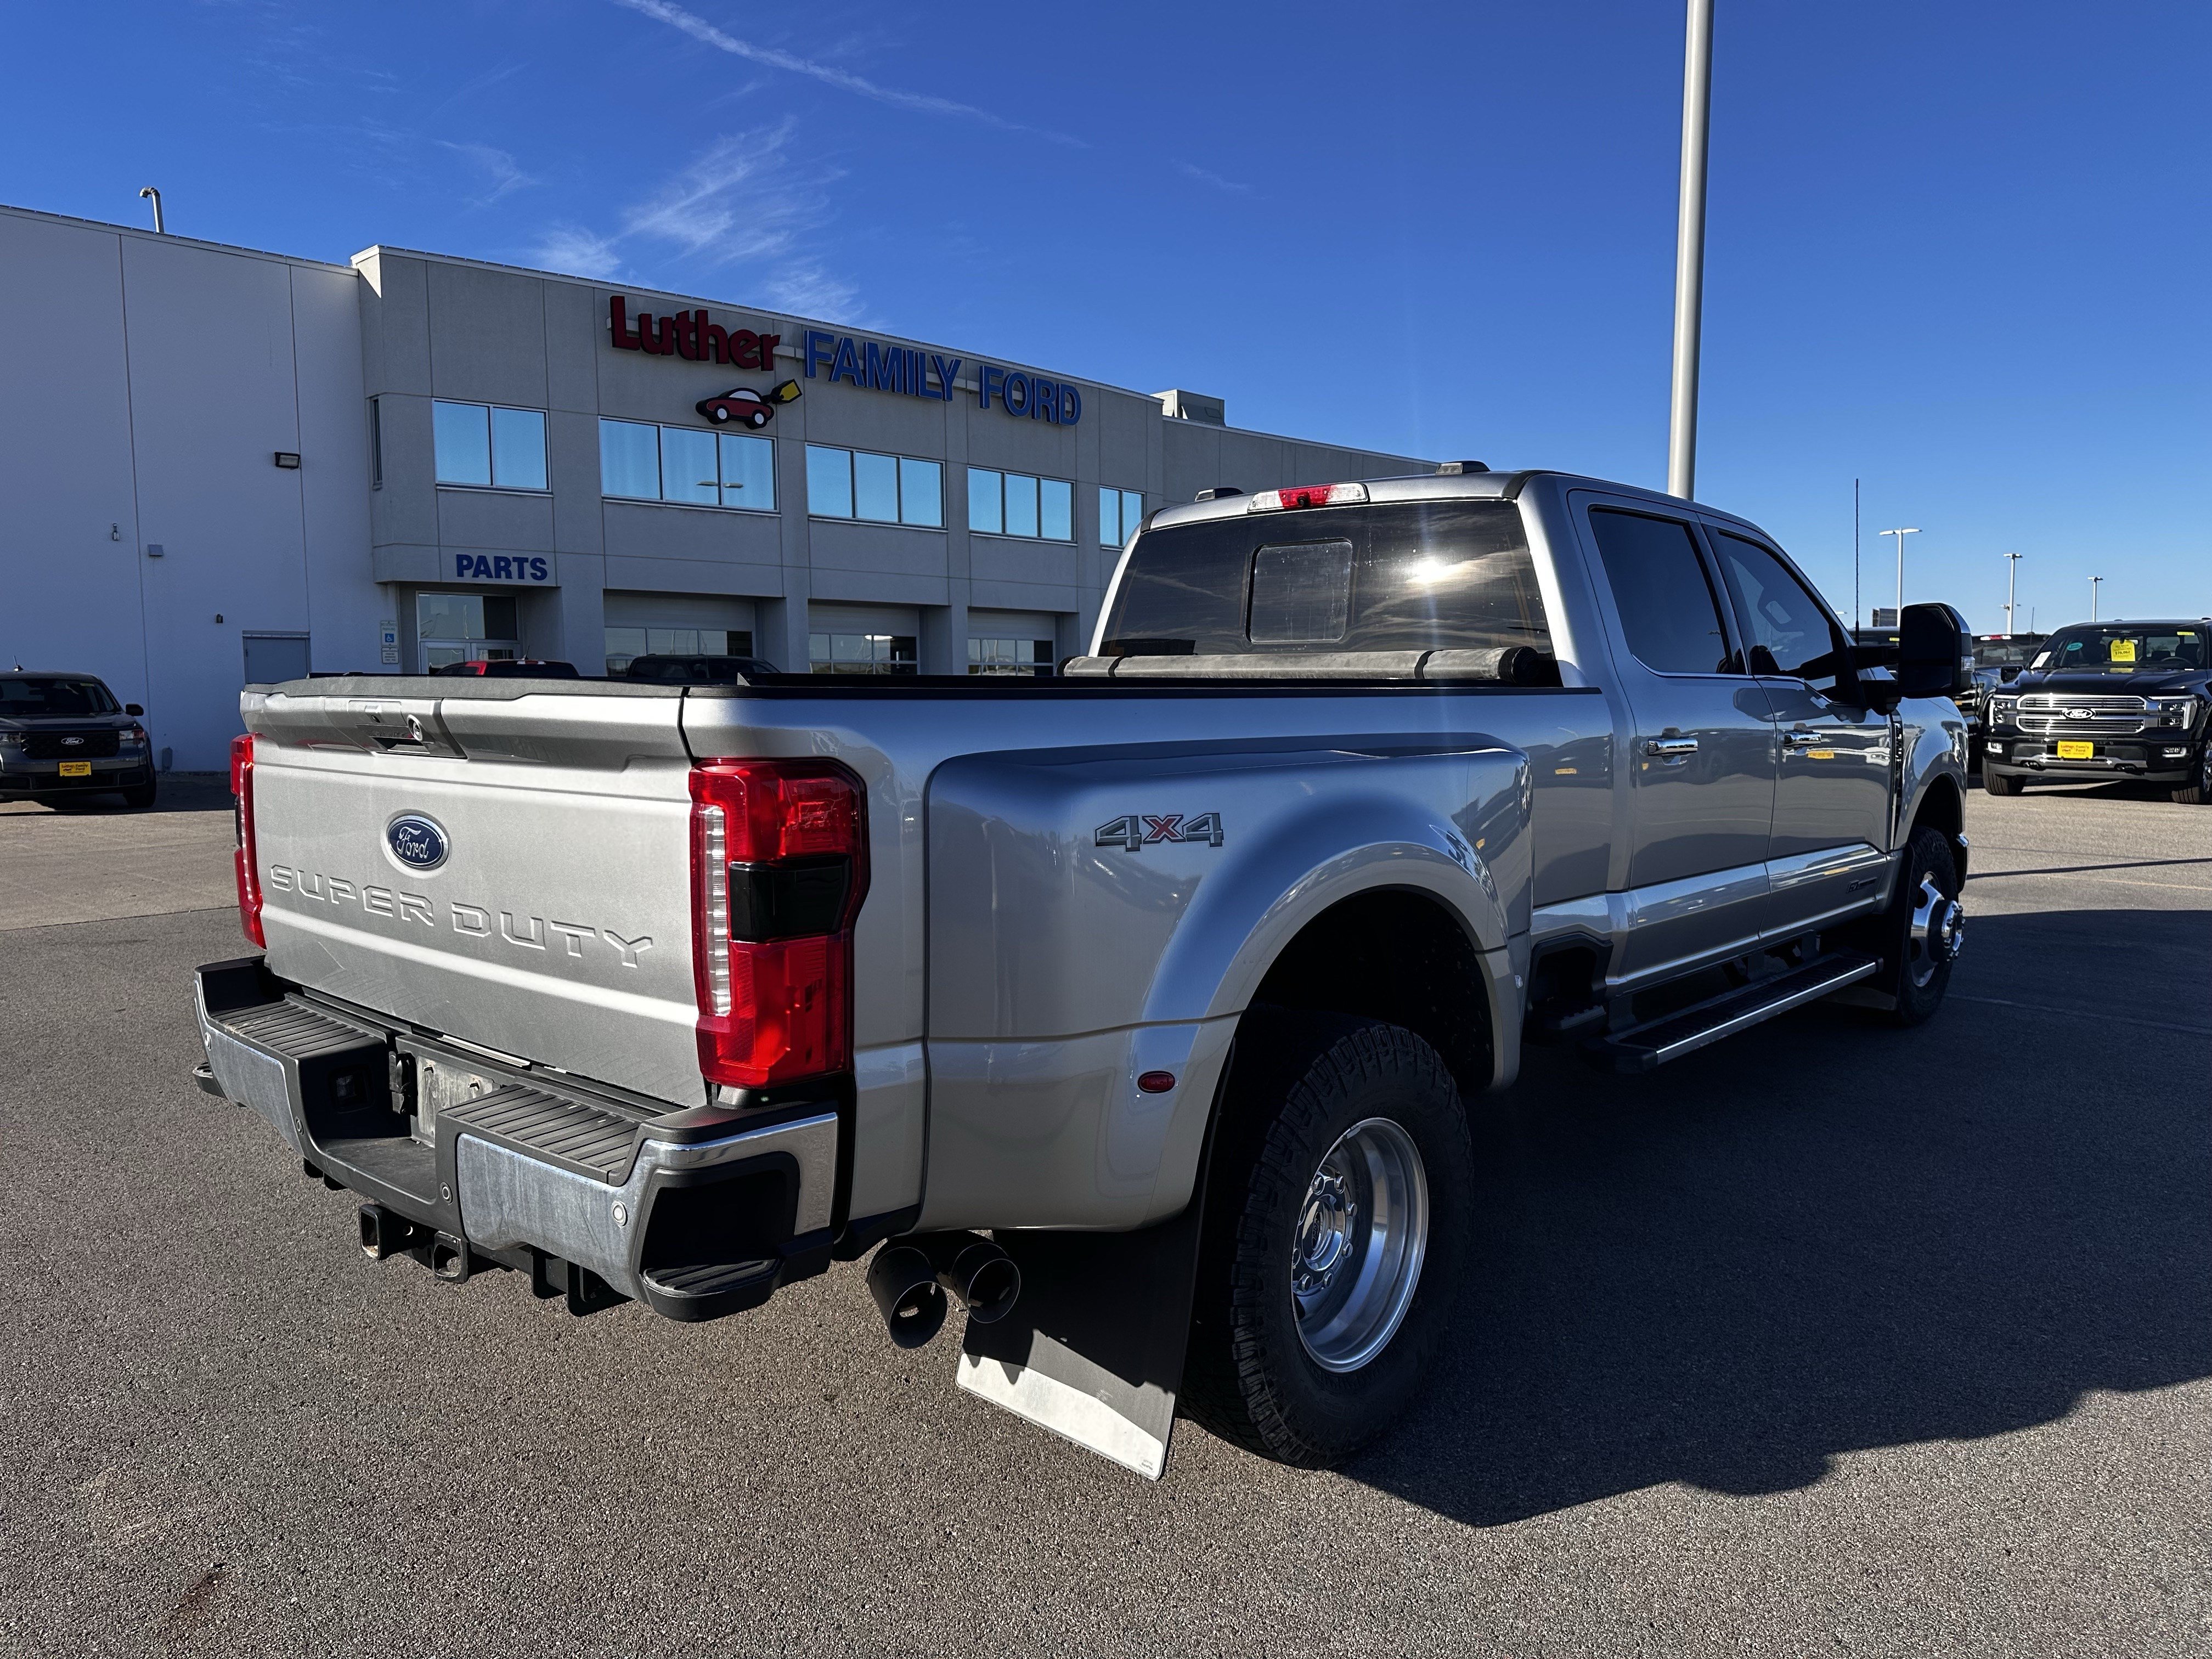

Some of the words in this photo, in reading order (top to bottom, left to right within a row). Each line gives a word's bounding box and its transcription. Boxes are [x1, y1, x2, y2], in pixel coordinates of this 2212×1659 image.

[610, 296, 781, 371] Luther
[804, 330, 962, 402] FAMILY
[979, 365, 1081, 426] FORD
[456, 554, 548, 580] PARTS
[397, 826, 430, 859] Ford
[270, 864, 434, 926] SUPER
[452, 902, 653, 968] DUTY
